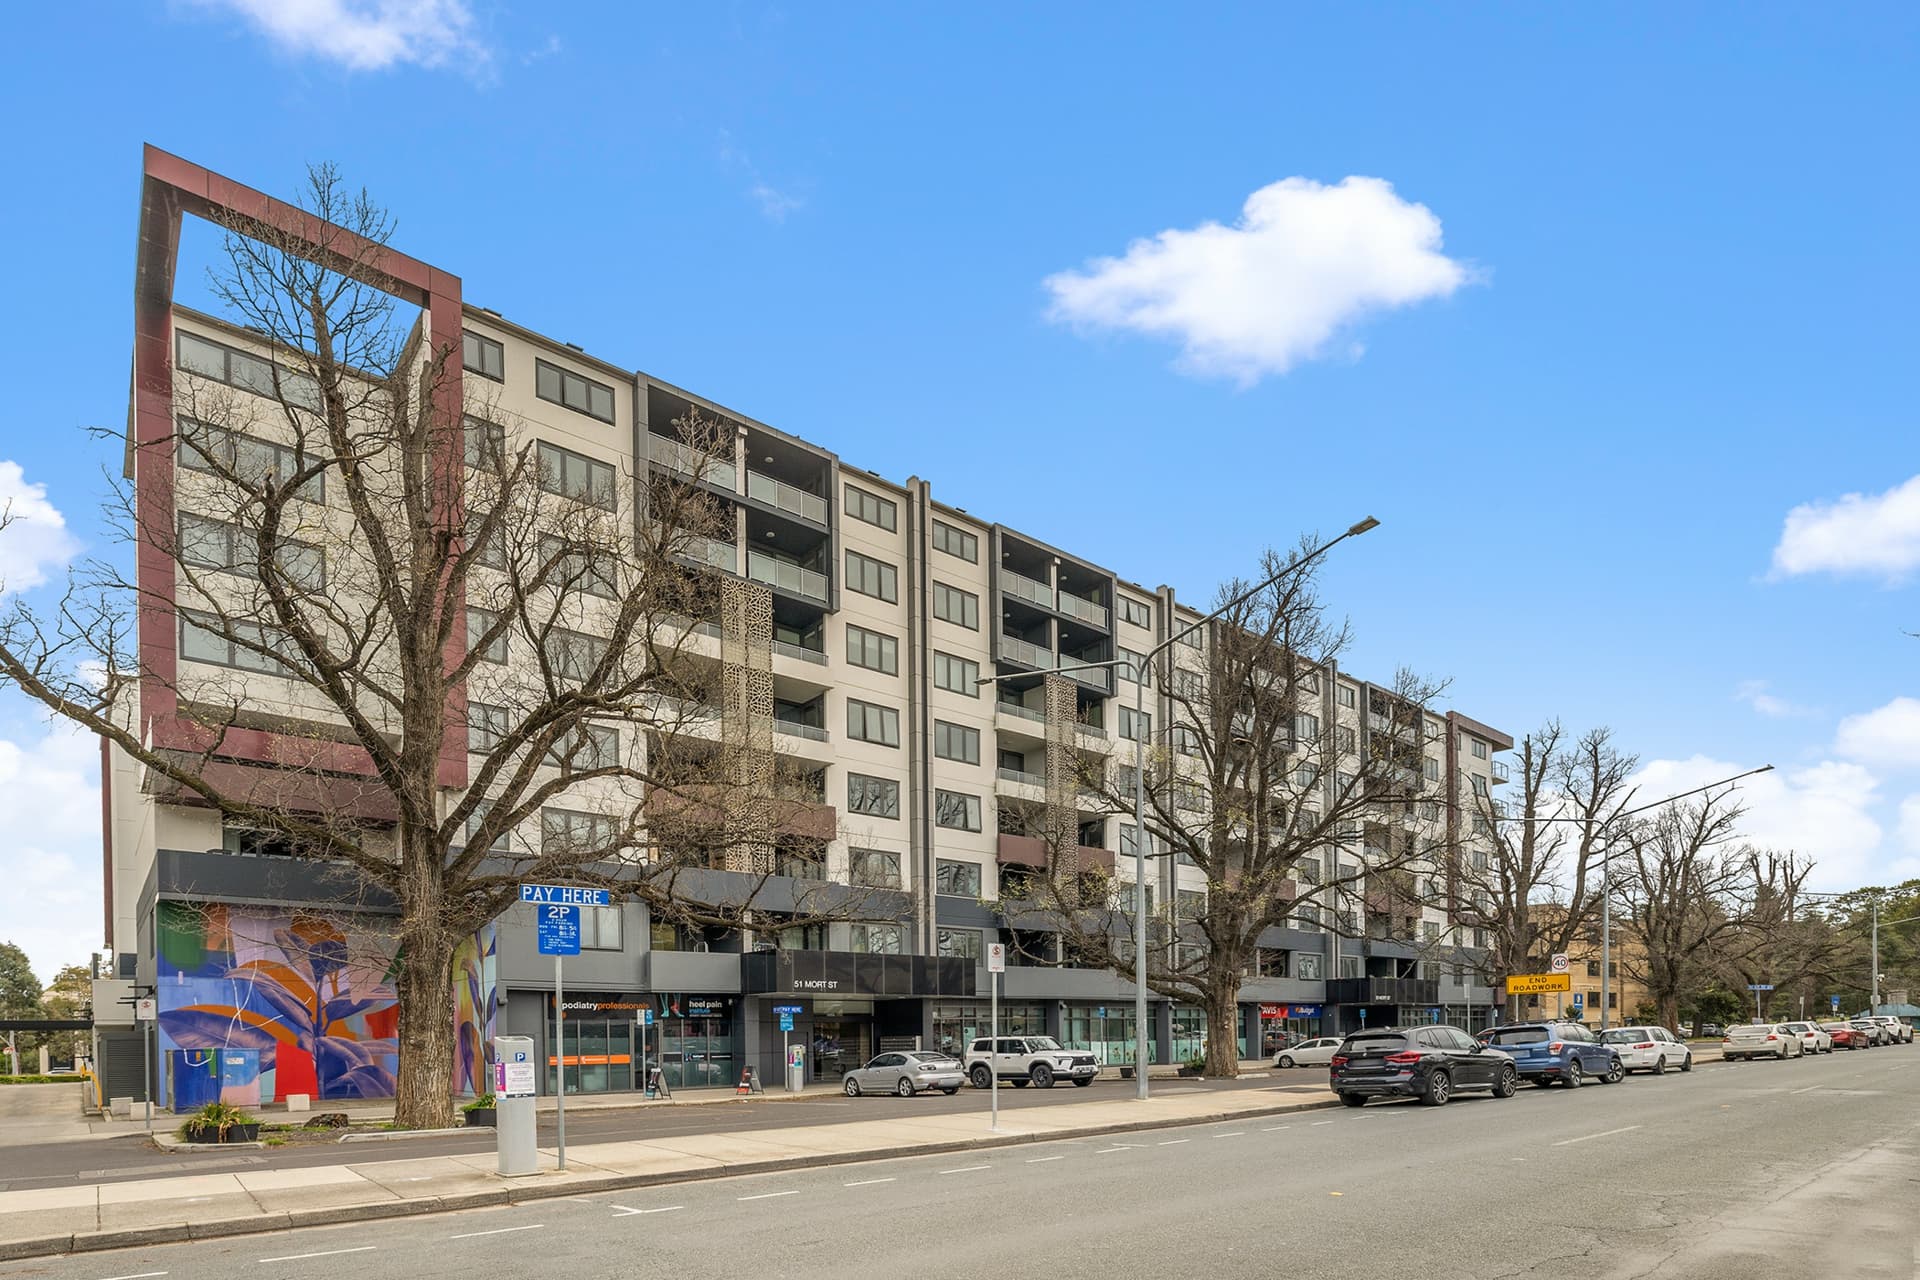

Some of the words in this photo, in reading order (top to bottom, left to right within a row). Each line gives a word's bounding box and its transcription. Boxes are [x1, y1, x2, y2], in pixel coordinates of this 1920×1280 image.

[522, 886, 554, 901] PAY
[562, 888, 602, 904] HERE
[548, 905, 570, 919] 2P
[1554, 959, 1566, 967] 40
[794, 980, 803, 989] 51
[804, 980, 827, 989] MORT
[827, 980, 838, 989] ST
[1528, 976, 1547, 984] END
[1513, 983, 1563, 992] ROADWORK
[689, 1000, 706, 1008] heel
[706, 1000, 723, 1009] pain
[1262, 1006, 1277, 1015] AVIS
